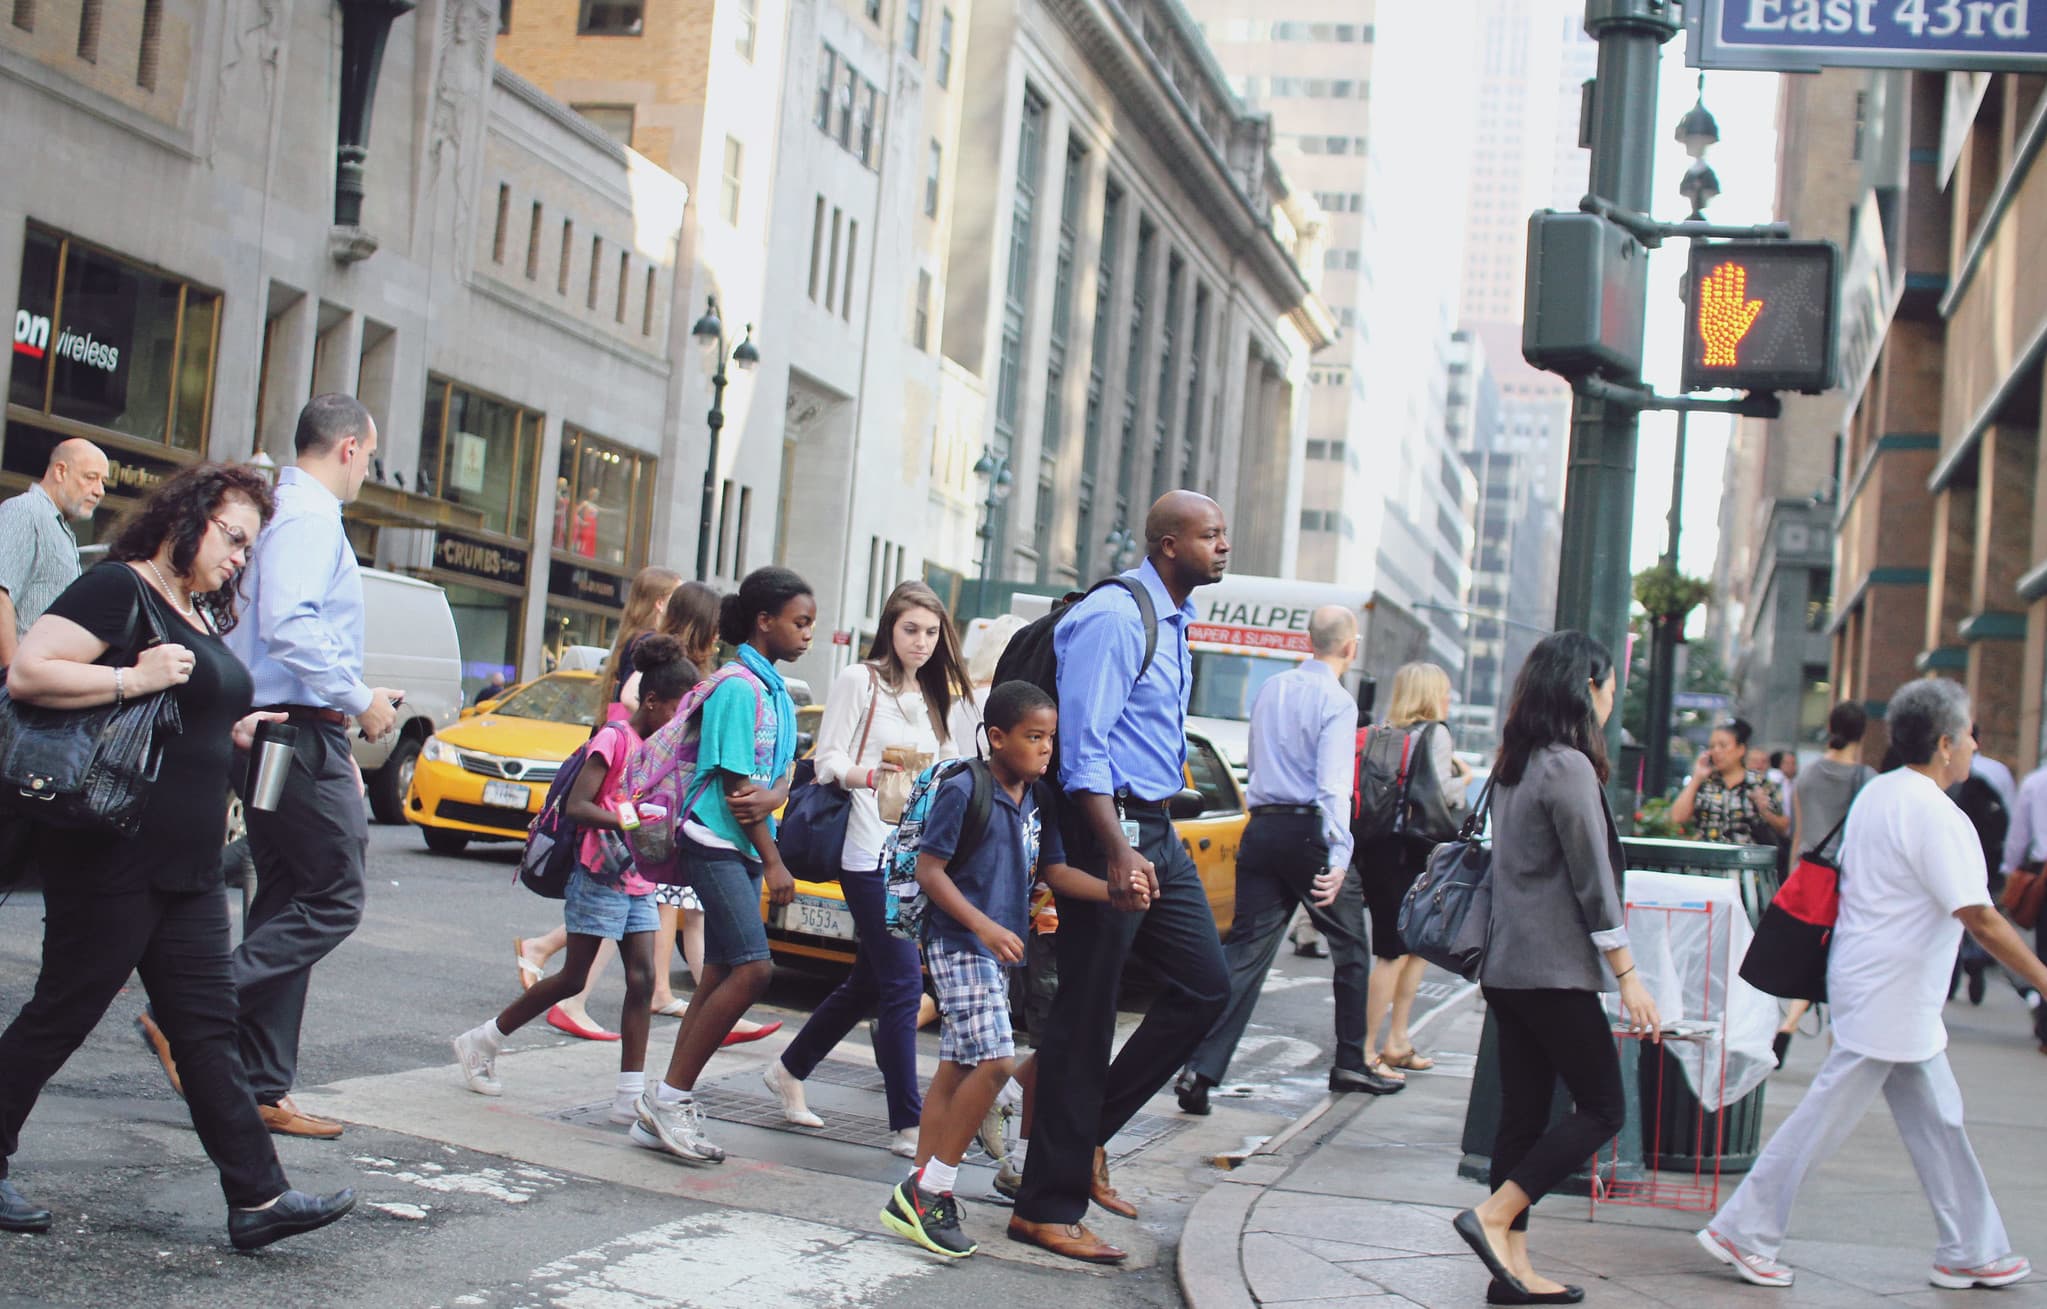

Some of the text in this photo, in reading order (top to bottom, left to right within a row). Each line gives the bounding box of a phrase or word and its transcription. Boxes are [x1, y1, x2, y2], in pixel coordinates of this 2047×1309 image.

[1743, 0, 2031, 38] East 43rd
[444, 538, 500, 574] CRUMBS
[1208, 601, 1313, 631] HALPE
[1189, 626, 1310, 650] PAPER & SUPPLIES
